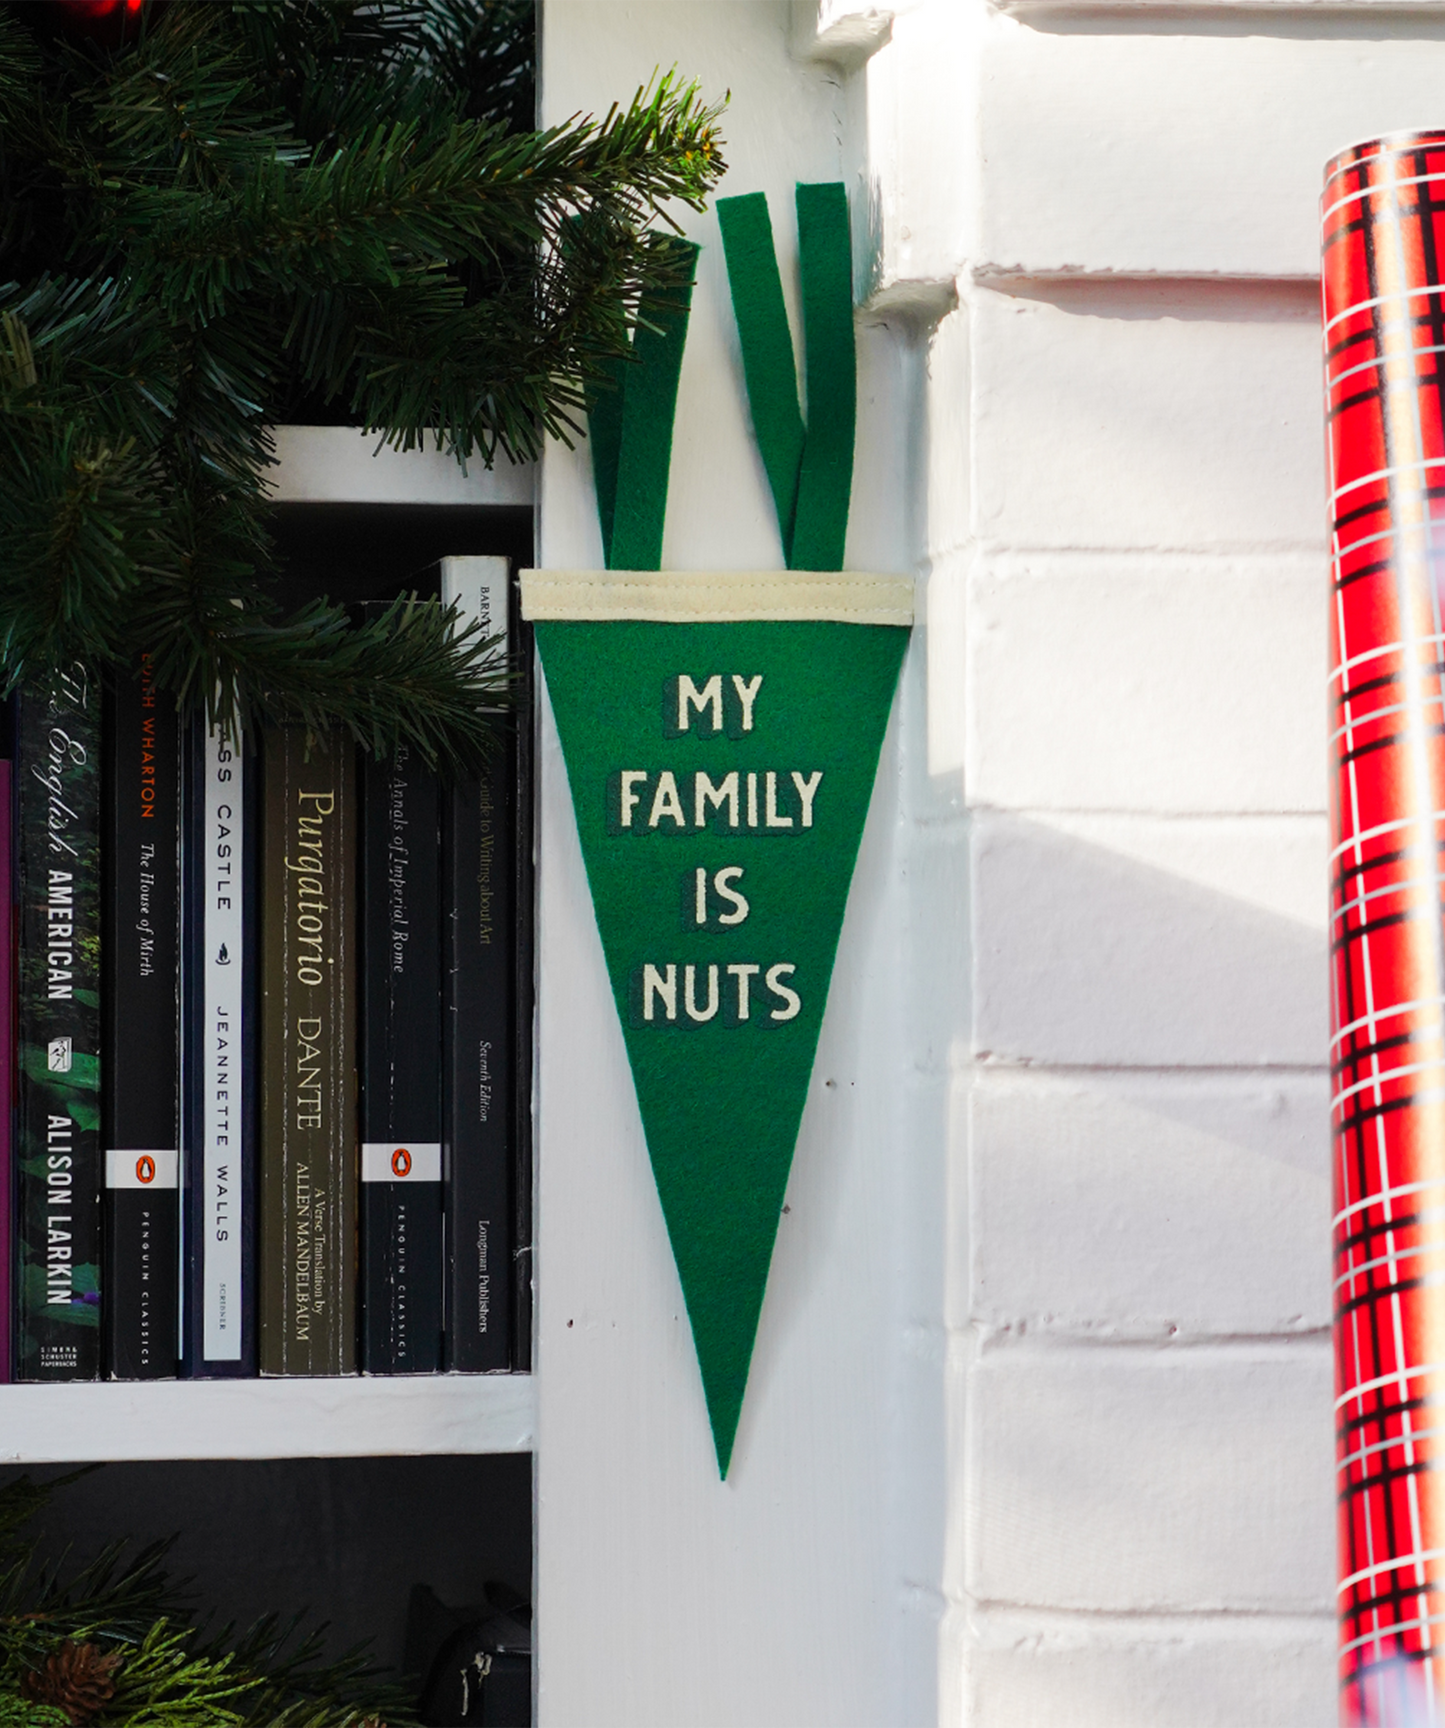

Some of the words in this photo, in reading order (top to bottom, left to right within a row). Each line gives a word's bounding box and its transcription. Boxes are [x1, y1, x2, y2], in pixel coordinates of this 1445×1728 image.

[678, 674, 763, 731] MY
[33, 728, 87, 857] English
[140, 719, 155, 818] WHARTON
[393, 778, 409, 830] Annals
[480, 820, 493, 833] to
[620, 770, 823, 828] FAMILY
[140, 843, 155, 868] The
[217, 804, 232, 910] CASTLE
[389, 836, 409, 855] of
[477, 834, 495, 883] Writing
[139, 872, 155, 914] House
[284, 788, 335, 987] Purgatorio
[390, 858, 410, 926] Imperial
[480, 885, 494, 923] about
[695, 866, 750, 925] IS
[47, 869, 73, 999] AMERICAN
[135, 918, 154, 936] of
[392, 931, 409, 974] Rome
[480, 923, 494, 946] Art
[139, 937, 154, 977] Mirth
[643, 963, 801, 1022] NUTS
[216, 1006, 229, 1146] JEANNETTE
[297, 1017, 322, 1130] DANTE
[479, 1040, 492, 1081] Seventh
[479, 1084, 492, 1122] Edition
[47, 1115, 73, 1204] ALISON
[216, 1165, 229, 1242] WALLS
[296, 1162, 311, 1217] ALLEN
[313, 1200, 326, 1232] Verse
[314, 1187, 325, 1199] A
[47, 1216, 73, 1304] LARKIN
[141, 1211, 150, 1280] PENGUIN
[314, 1234, 327, 1298] Translation
[397, 1204, 406, 1275] PENGUIN
[476, 1220, 491, 1272] Longman
[219, 1282, 228, 1331] SCRIBNER
[295, 1221, 311, 1340] MANDELBAUM
[311, 1300, 326, 1315] by
[478, 1274, 491, 1333] Publishers
[141, 1291, 150, 1365] CLASSICS
[397, 1284, 407, 1358] CLASSICS
